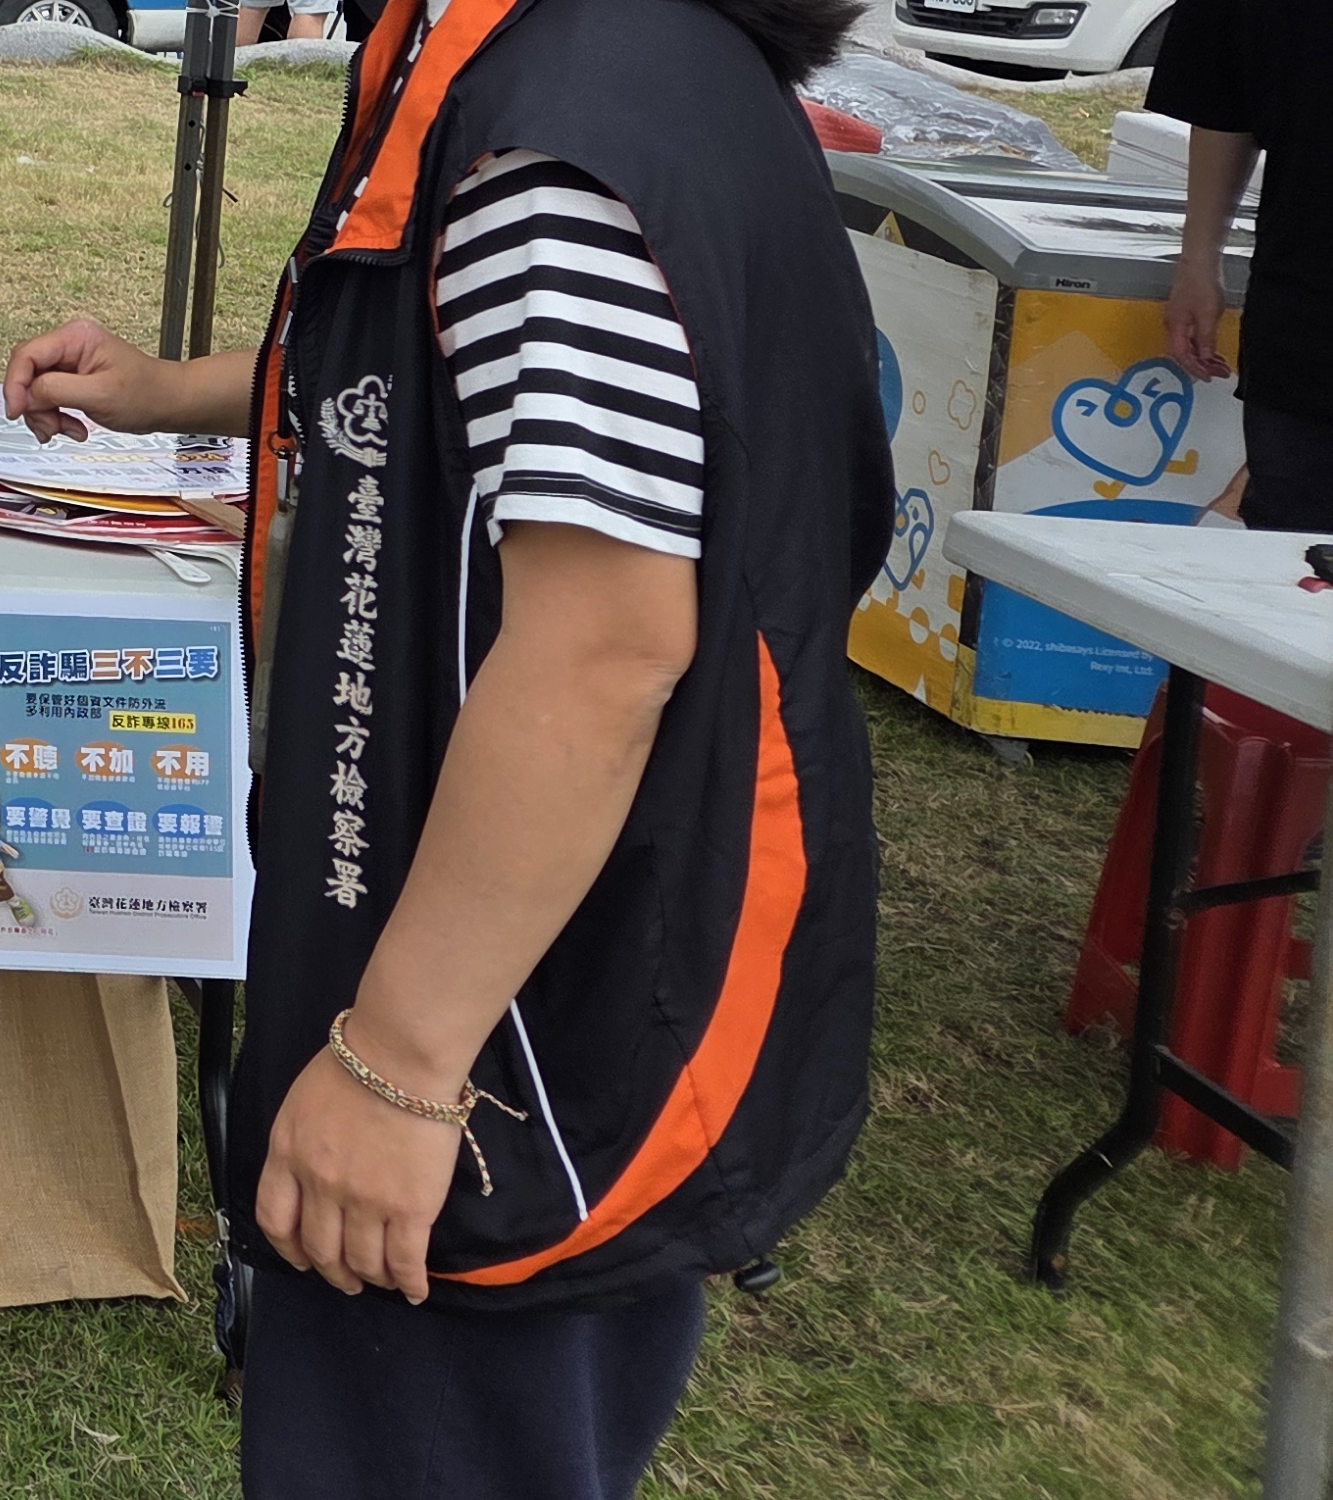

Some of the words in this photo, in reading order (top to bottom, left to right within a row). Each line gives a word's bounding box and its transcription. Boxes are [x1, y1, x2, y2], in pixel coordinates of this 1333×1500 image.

[323, 474, 385, 908] 臺灣花蓮地方檢察署
[111, 713, 196, 730] 反詐專線165
[5, 743, 59, 771] 不聽
[80, 747, 134, 774] 不加
[156, 750, 211, 777] 不用
